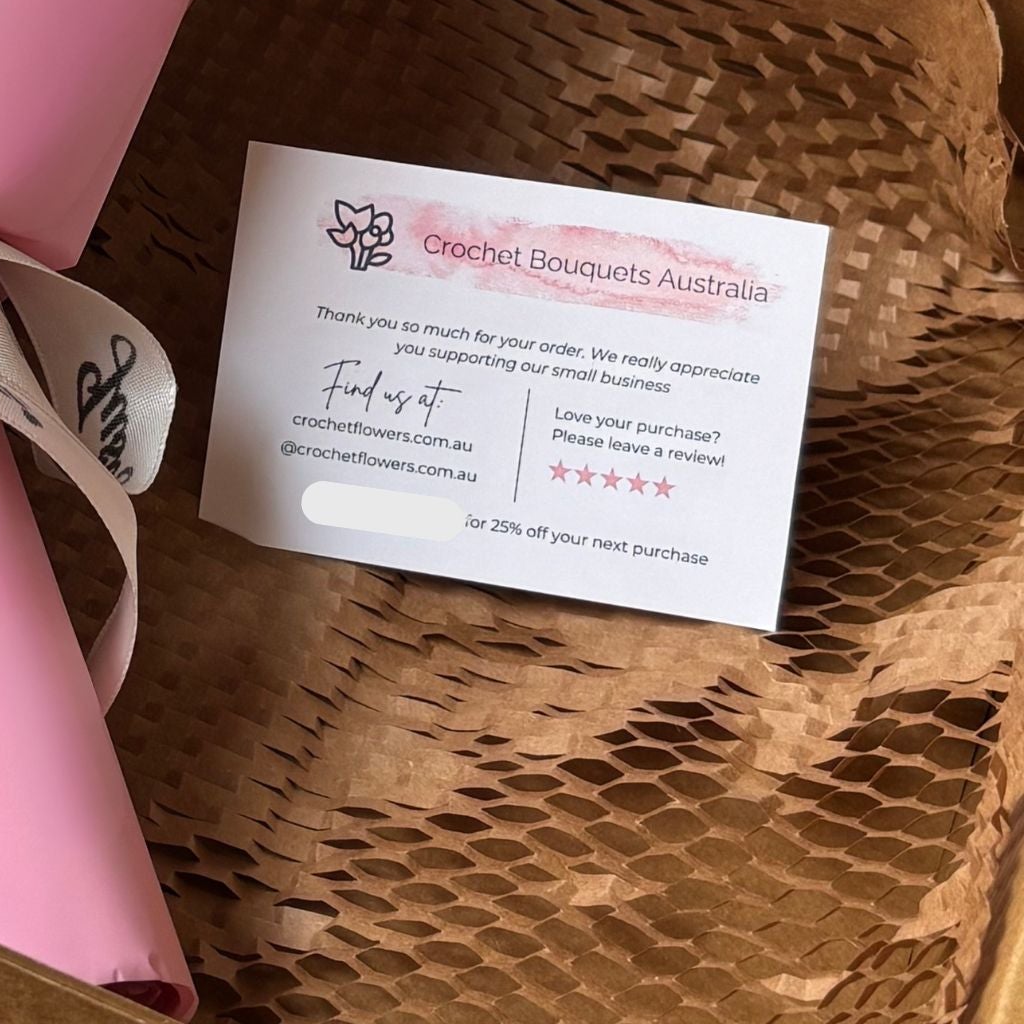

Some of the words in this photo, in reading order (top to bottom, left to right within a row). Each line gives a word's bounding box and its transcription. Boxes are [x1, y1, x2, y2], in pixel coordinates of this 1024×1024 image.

[422, 232, 523, 269] Crochet
[528, 247, 652, 286] Bouquets
[655, 266, 768, 303] Australia
[316, 304, 366, 326] Thank
[365, 315, 398, 330] you
[399, 320, 420, 334] so
[421, 323, 471, 341] much
[472, 328, 497, 345] for
[496, 334, 537, 351] your
[537, 341, 585, 359] order.
[590, 345, 618, 363] We
[620, 353, 669, 373] really
[668, 360, 761, 385] appreciate
[392, 341, 426, 357] you
[426, 346, 518, 373] supporting
[519, 360, 550, 375] our
[550, 365, 598, 383] small
[598, 369, 672, 394] business
[320, 358, 383, 413] Find
[382, 389, 413, 410] us
[416, 378, 463, 428] at:
[291, 414, 473, 453] crochetflowers.com.au
[550, 427, 605, 449] Please
[607, 434, 651, 456] leave
[652, 445, 664, 458] a
[666, 448, 726, 468] review!
[553, 405, 593, 425] Love
[593, 414, 633, 431] your
[635, 421, 721, 444] purchase?
[279, 439, 478, 483] @crochetflowers.com.au
[489, 517, 523, 536] 25%
[524, 524, 550, 540] off
[549, 529, 589, 546] your
[591, 536, 629, 554] next
[631, 543, 709, 566] purchase
